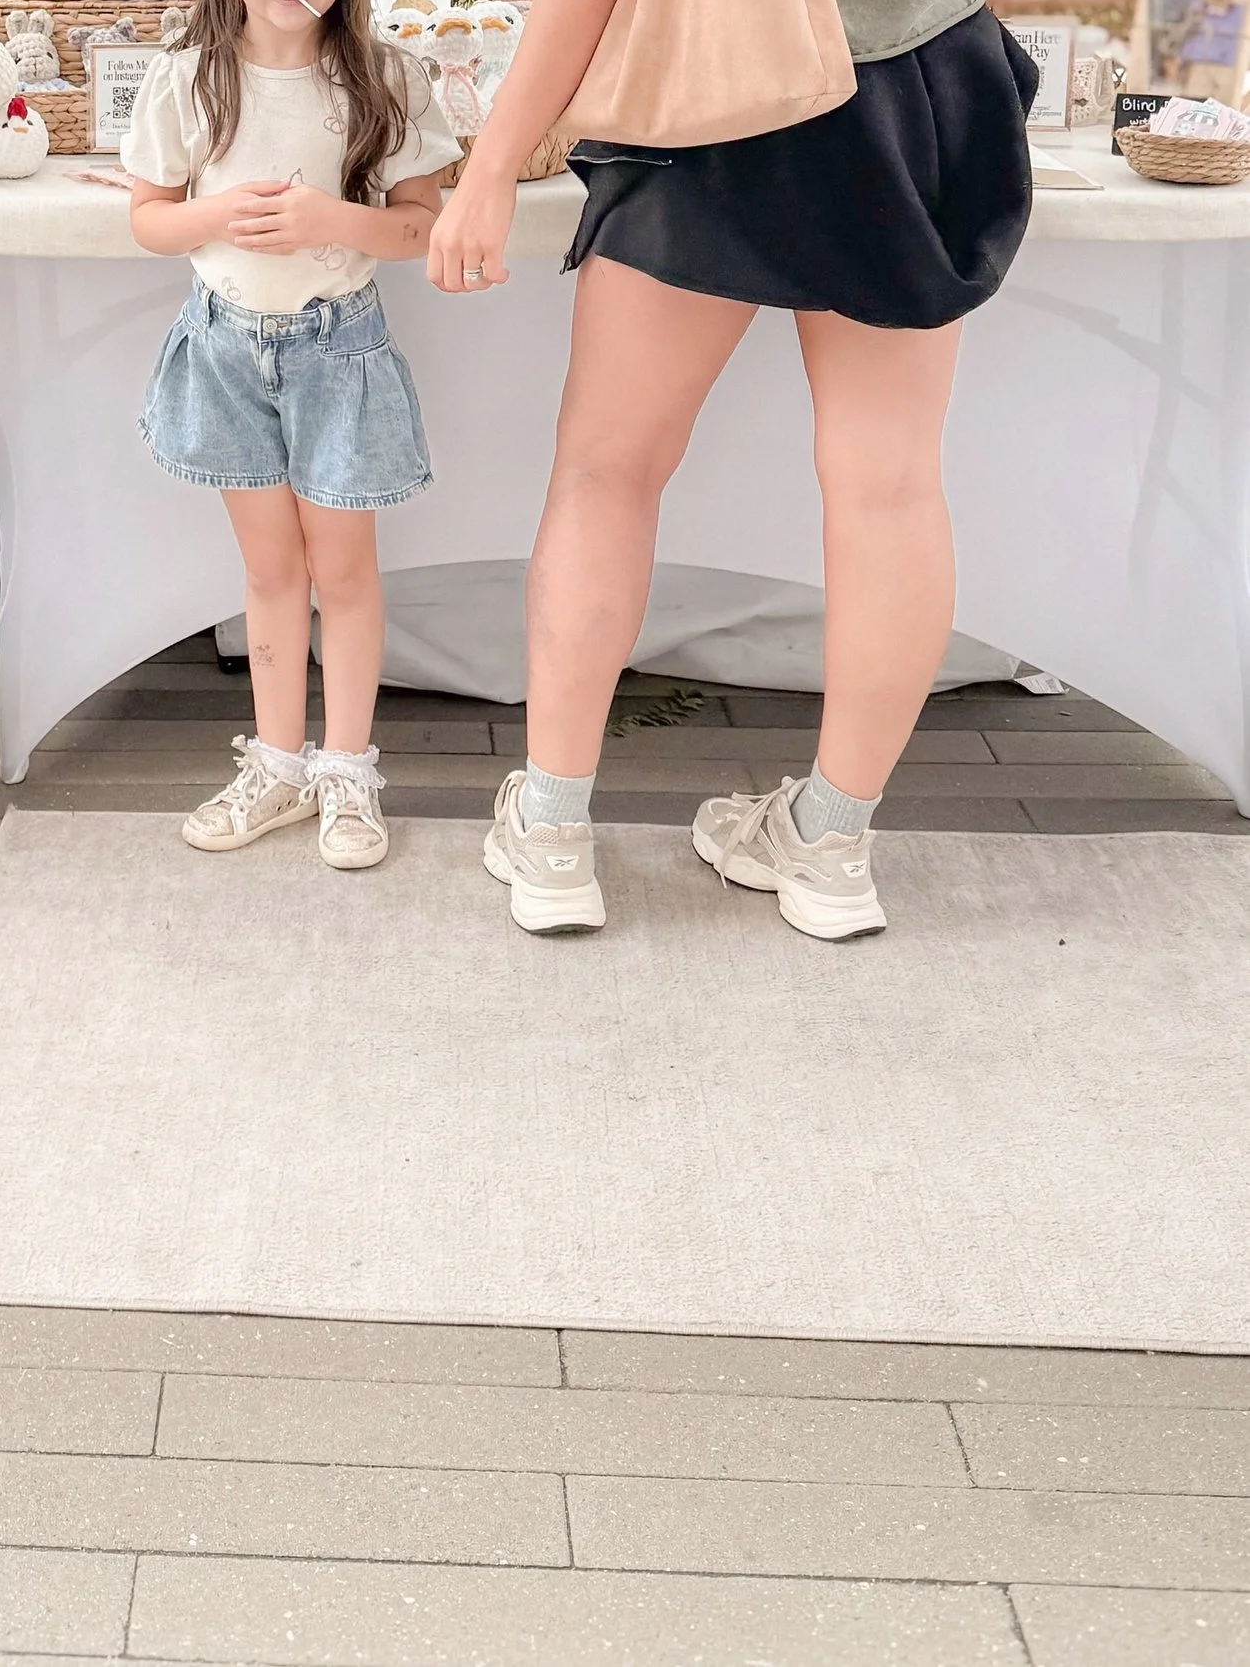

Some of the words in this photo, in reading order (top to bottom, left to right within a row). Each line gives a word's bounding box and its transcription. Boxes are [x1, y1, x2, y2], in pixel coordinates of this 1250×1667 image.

[1030, 44, 1050, 61] Pay
[108, 60, 134, 71] Follow
[1122, 98, 1156, 112] Blind
